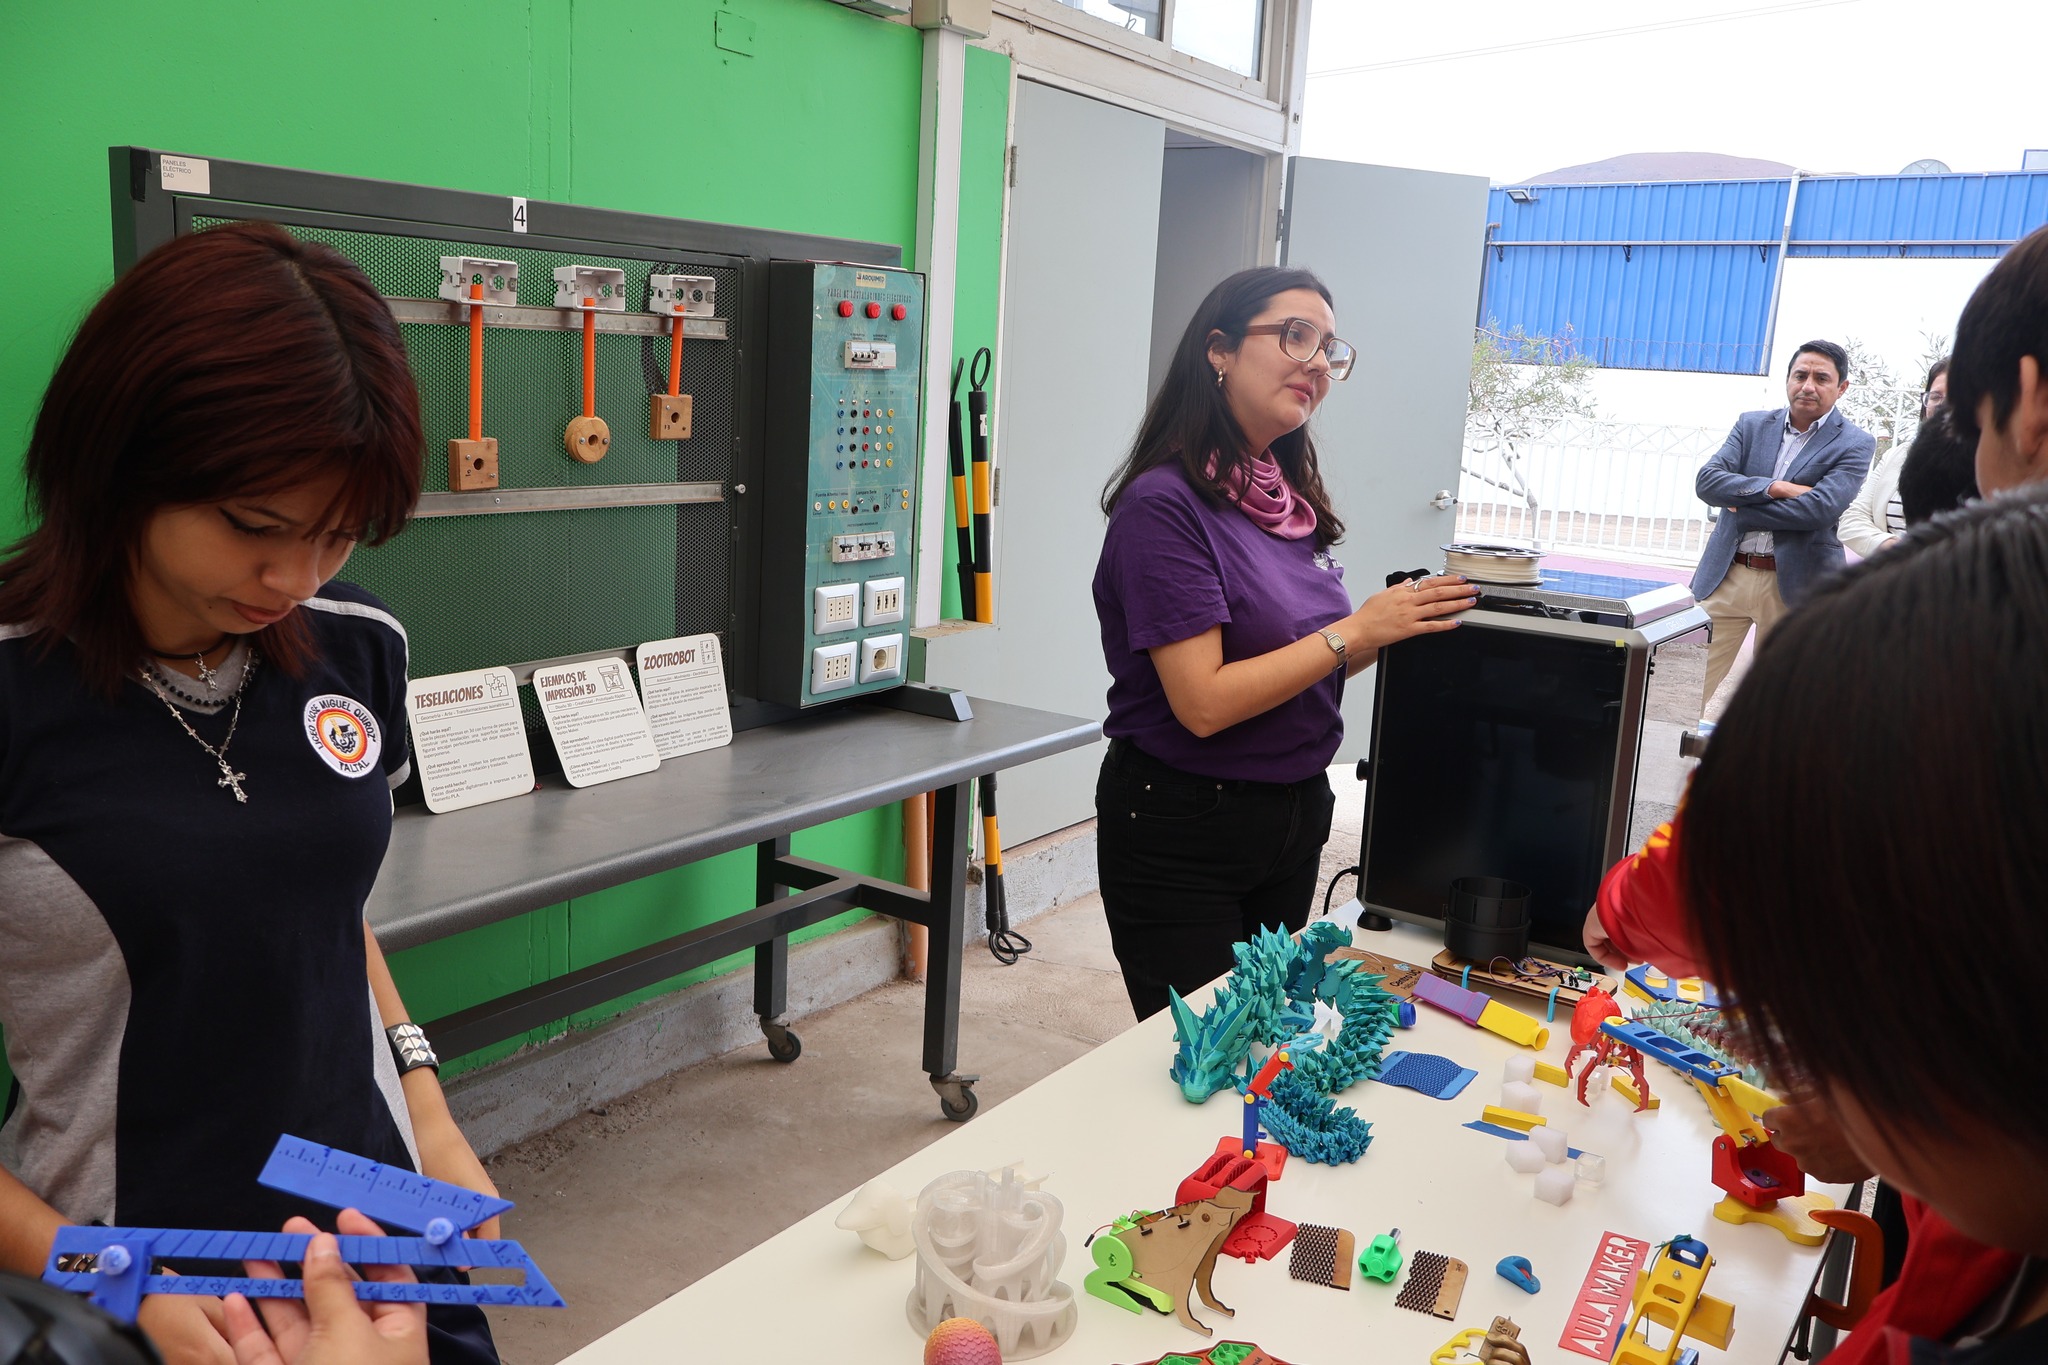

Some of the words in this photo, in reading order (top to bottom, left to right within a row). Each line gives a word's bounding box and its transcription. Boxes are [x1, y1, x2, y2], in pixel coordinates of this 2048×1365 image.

[514, 205, 525, 226] 4
[644, 649, 695, 670] ZOOTROBOT
[540, 672, 576, 688] EJEMPLOS
[577, 671, 587, 680] DE
[415, 685, 484, 709] TESELACIONES
[545, 682, 585, 701] IMPRESIÓN
[586, 683, 596, 694] 3D
[309, 725, 324, 749] LICEO
[319, 699, 351, 712] MIGUEL
[339, 760, 370, 772] TALTAL
[1590, 1237, 1639, 1299] MAKER
[1571, 1300, 1618, 1354] AULA
